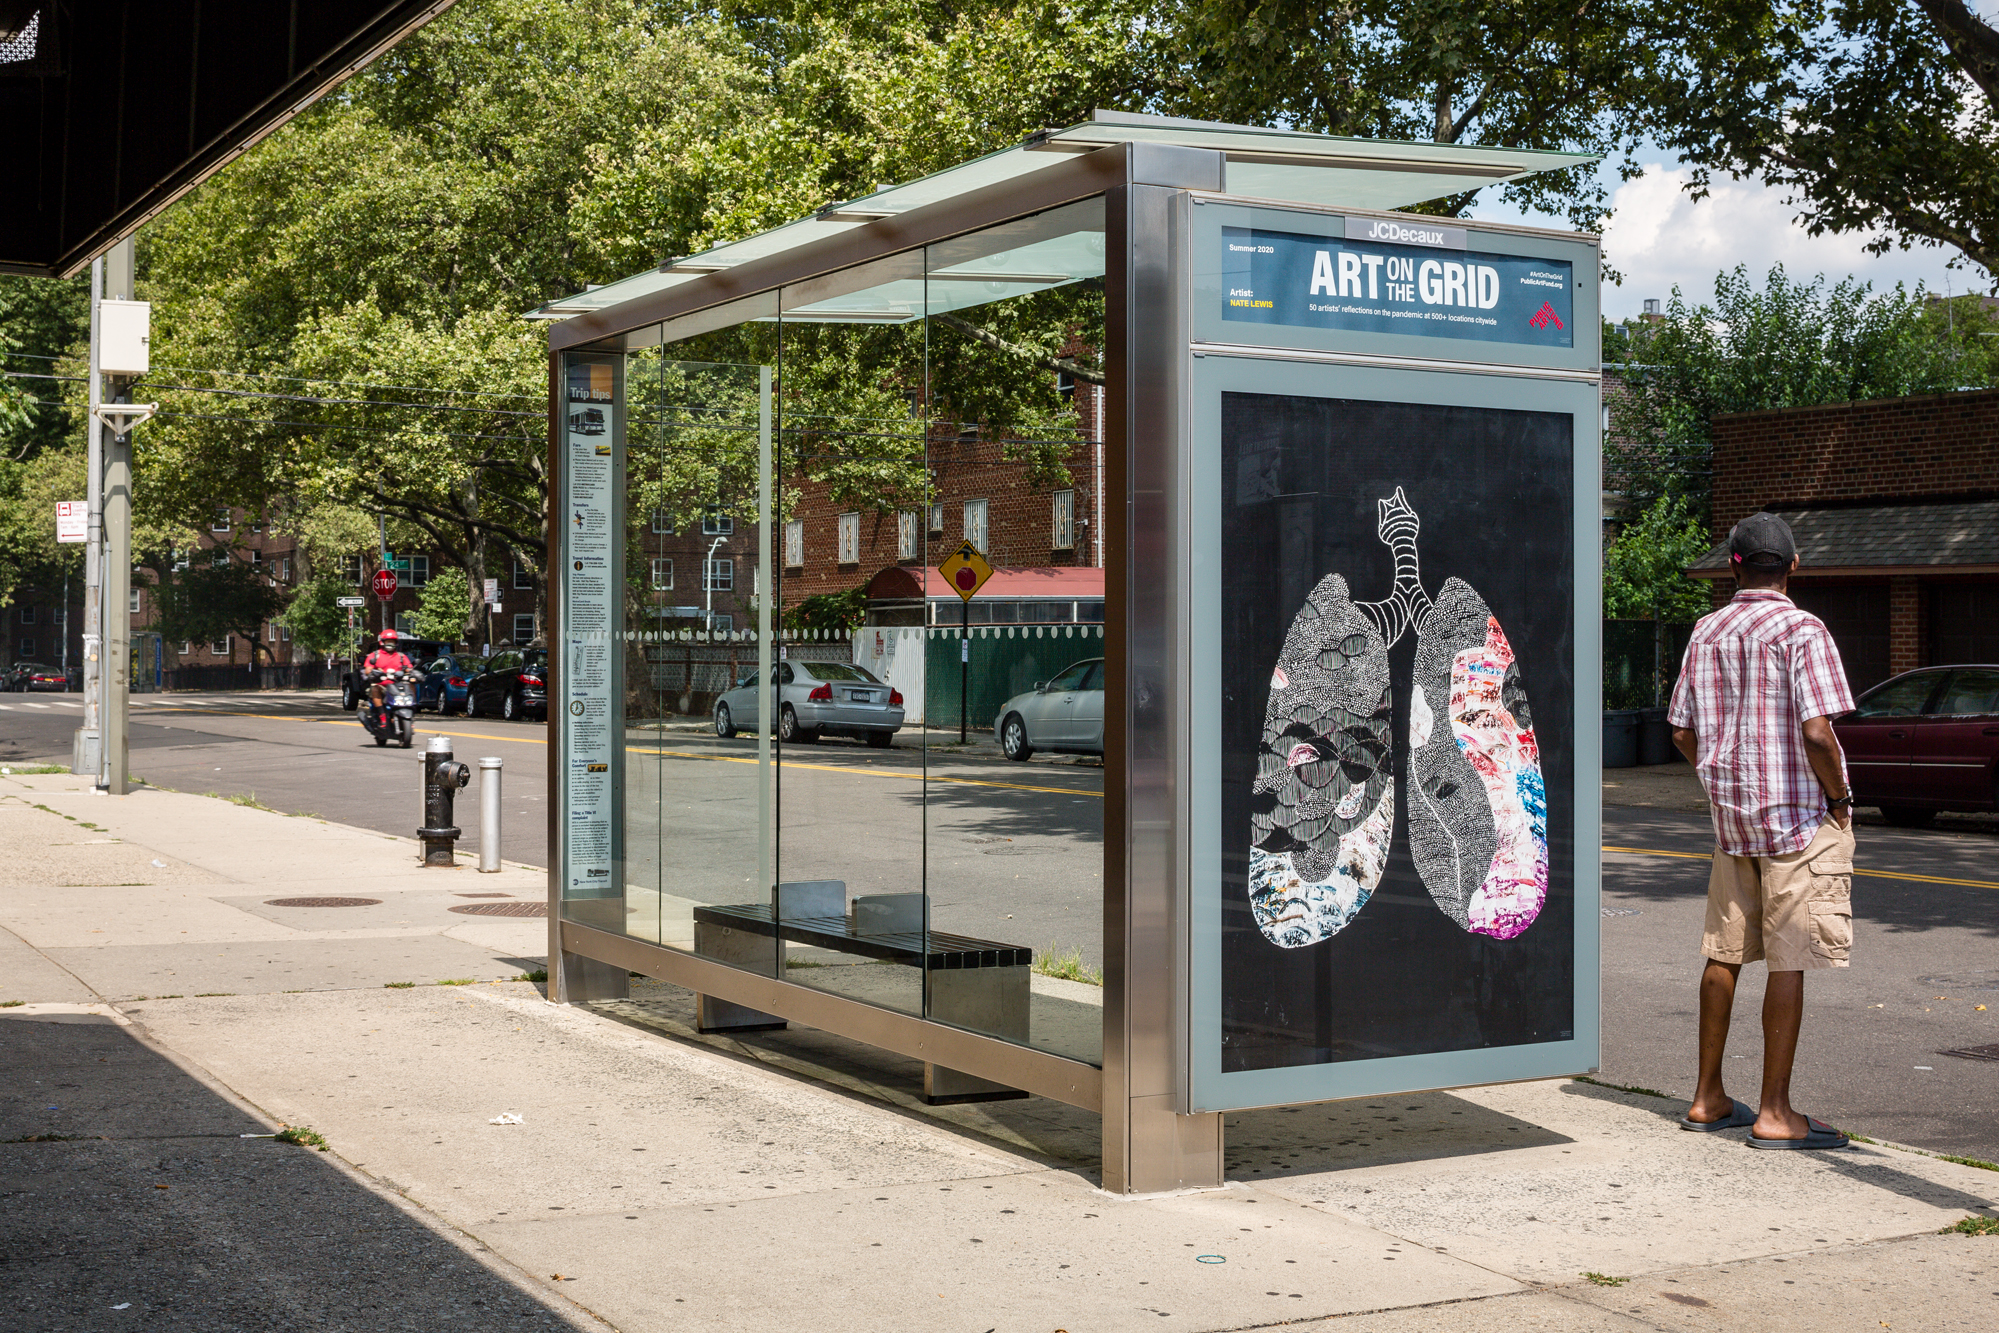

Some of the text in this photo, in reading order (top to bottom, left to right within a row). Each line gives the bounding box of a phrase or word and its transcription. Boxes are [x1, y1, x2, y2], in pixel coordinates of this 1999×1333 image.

[1369, 222, 1444, 245] JCDecaux
[1229, 244, 1274, 254] Summer 2020
[1310, 250, 1384, 300] ART
[1386, 256, 1413, 281] ON
[1530, 271, 1563, 280] #ArtOnTheGrid
[1230, 288, 1253, 297] Artist:
[1386, 282, 1415, 302] THE
[1418, 260, 1500, 310] GRID
[1520, 278, 1563, 289] PublicArtFund.org
[1230, 299, 1273, 308] NATE LEWIS
[1309, 303, 1317, 311] 50
[1341, 305, 1373, 314] reflections
[1382, 308, 1391, 317] the
[1392, 310, 1423, 319] pandemic
[1431, 312, 1447, 320] 500+
[1448, 313, 1475, 323] locations
[1475, 316, 1497, 326] citywide
[1529, 301, 1551, 328] PUBLIC
[1539, 313, 1551, 330] ART
[1548, 307, 1564, 330] FUND
[570, 386, 611, 401] Trip tips
[374, 578, 396, 589] STOP
